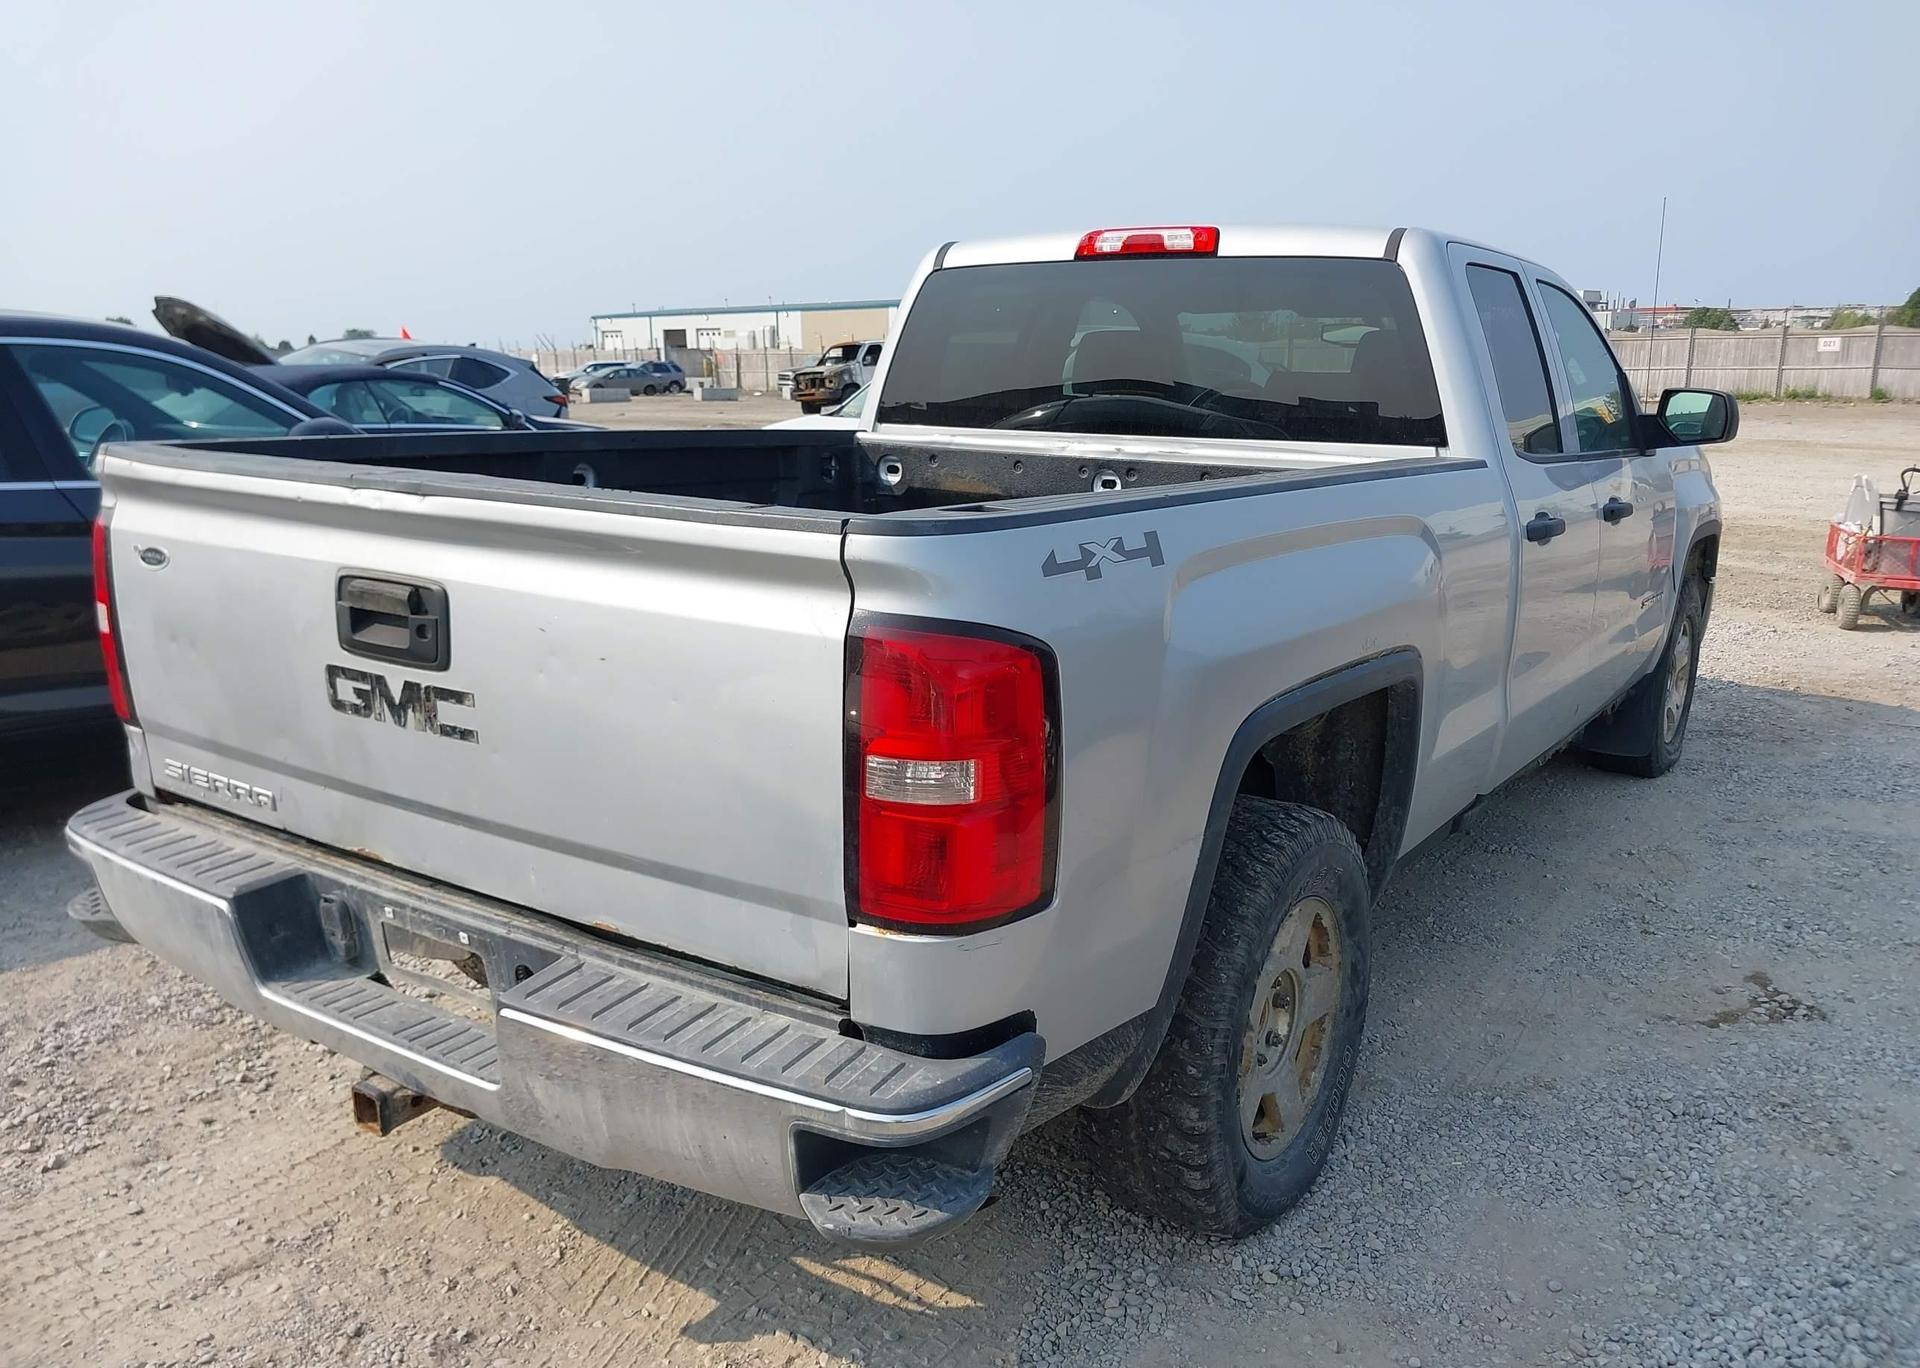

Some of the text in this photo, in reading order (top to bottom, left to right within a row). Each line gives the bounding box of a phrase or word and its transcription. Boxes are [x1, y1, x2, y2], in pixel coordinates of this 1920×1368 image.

[325, 663, 480, 745] GMC
[163, 758, 278, 812] SIERRA
[1306, 1044, 1353, 1165] COOPER
